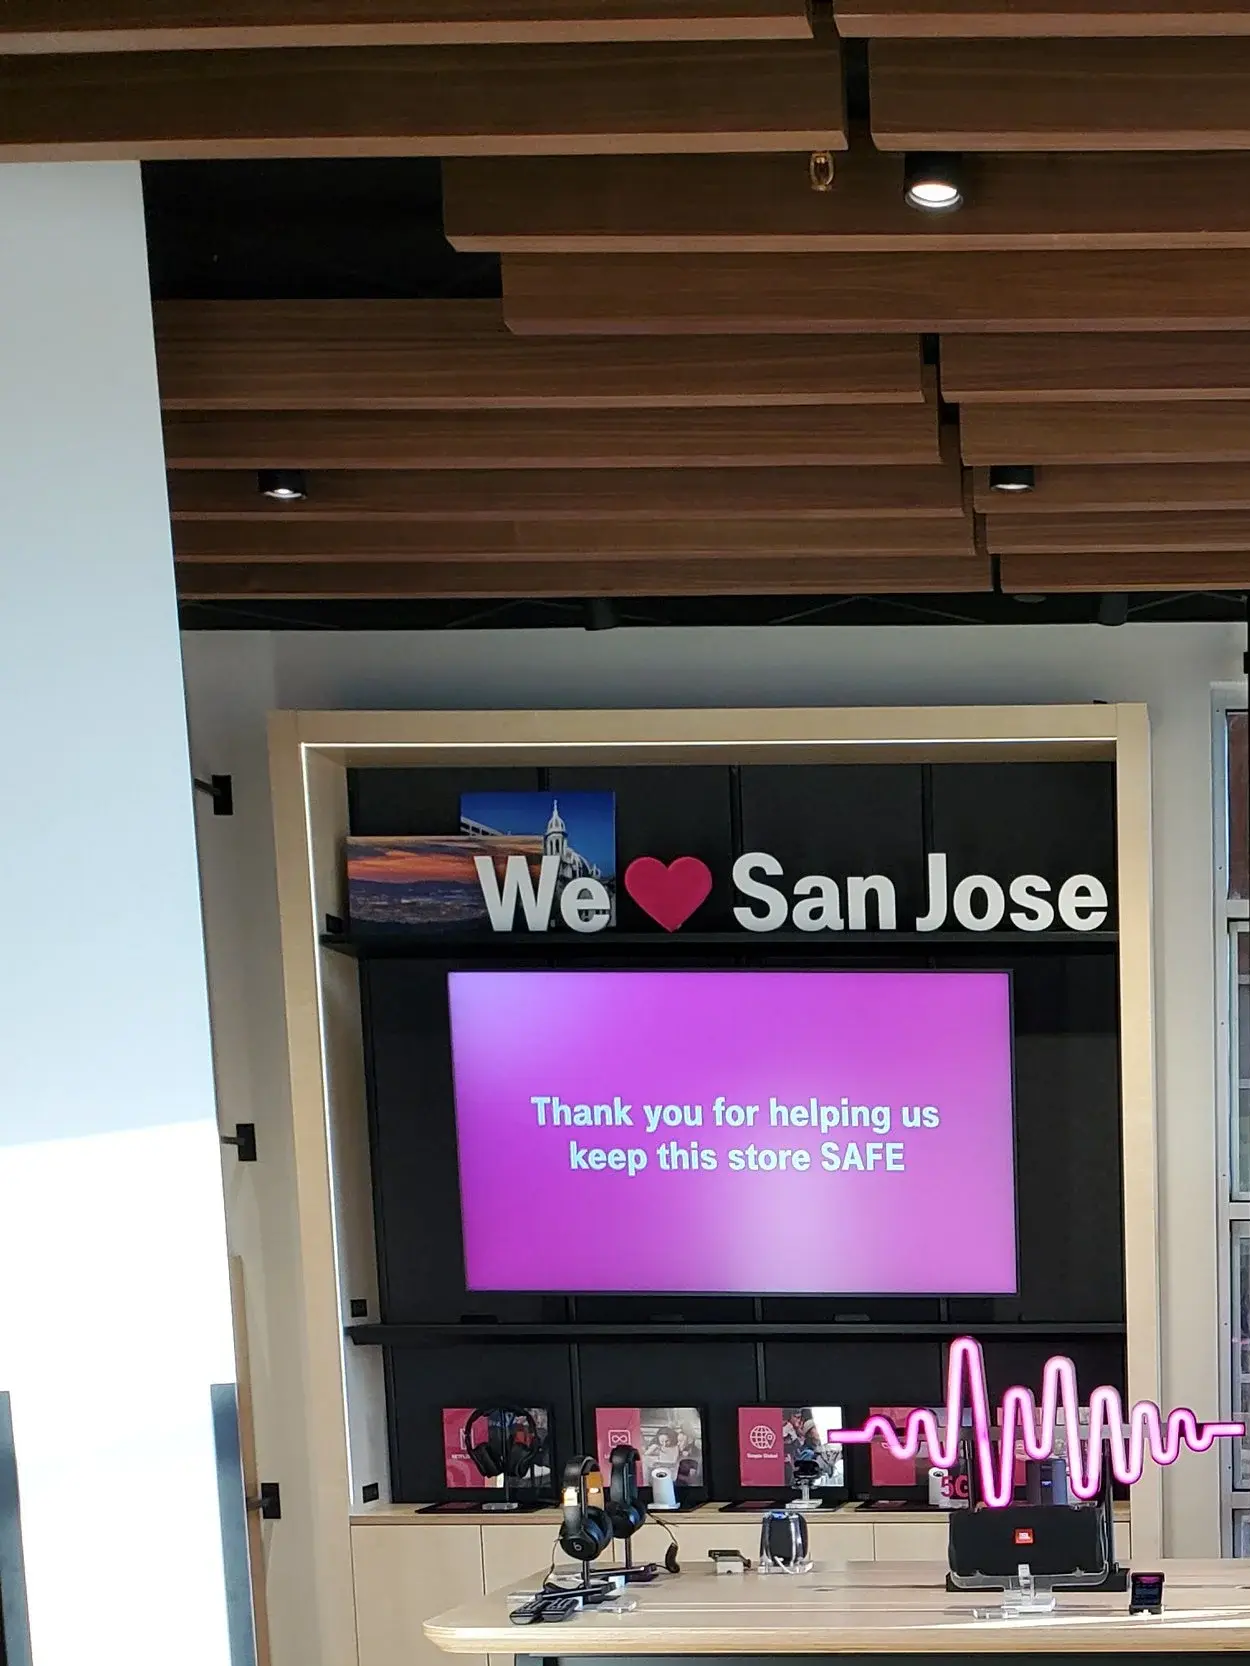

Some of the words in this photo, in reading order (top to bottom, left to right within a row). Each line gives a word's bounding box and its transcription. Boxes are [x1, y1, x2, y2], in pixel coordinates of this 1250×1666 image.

[473, 855, 613, 933] We
[732, 852, 897, 933] San
[915, 852, 1109, 933] Jose
[530, 1096, 634, 1126] Thank
[643, 1104, 703, 1133] you
[713, 1096, 759, 1127] for
[769, 1097, 891, 1134] helping
[902, 1105, 940, 1128] us
[569, 1140, 648, 1177] keep
[657, 1141, 718, 1171] this
[728, 1143, 811, 1171] store
[820, 1141, 905, 1172] SAFE
